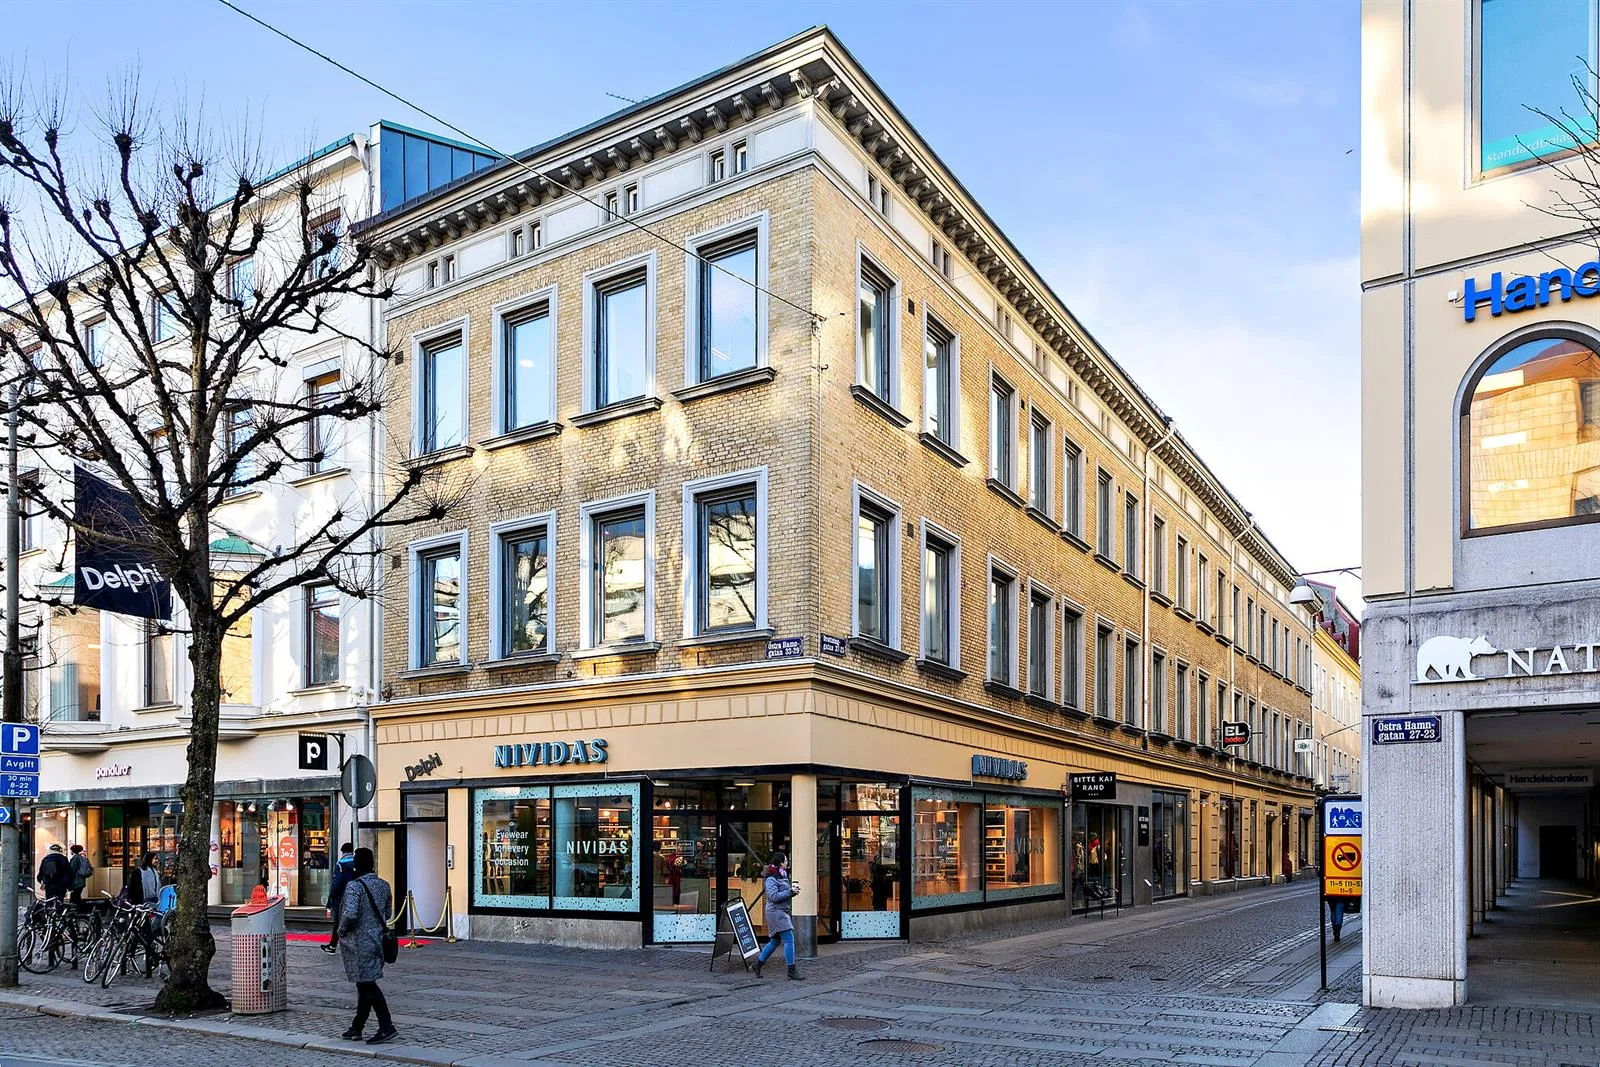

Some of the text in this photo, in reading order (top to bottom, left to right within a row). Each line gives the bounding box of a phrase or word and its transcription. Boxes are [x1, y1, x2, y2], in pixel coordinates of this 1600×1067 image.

[80, 562, 164, 593] Delphi
[1225, 725, 1246, 736] EL
[1378, 720, 1435, 731] Östra Hamn-
[13, 727, 31, 751] P
[1378, 729, 1435, 742] gatan 27-23
[494, 738, 609, 768] NIVIDAS
[6, 759, 34, 770] Avgift
[96, 763, 132, 780] panduro
[404, 752, 443, 781] Delphi
[972, 755, 1028, 780] NIVIDAS
[495, 829, 529, 841] Eyewear
[507, 844, 529, 855] every
[566, 839, 628, 854] NIVIDAS
[494, 856, 529, 866] occasion
